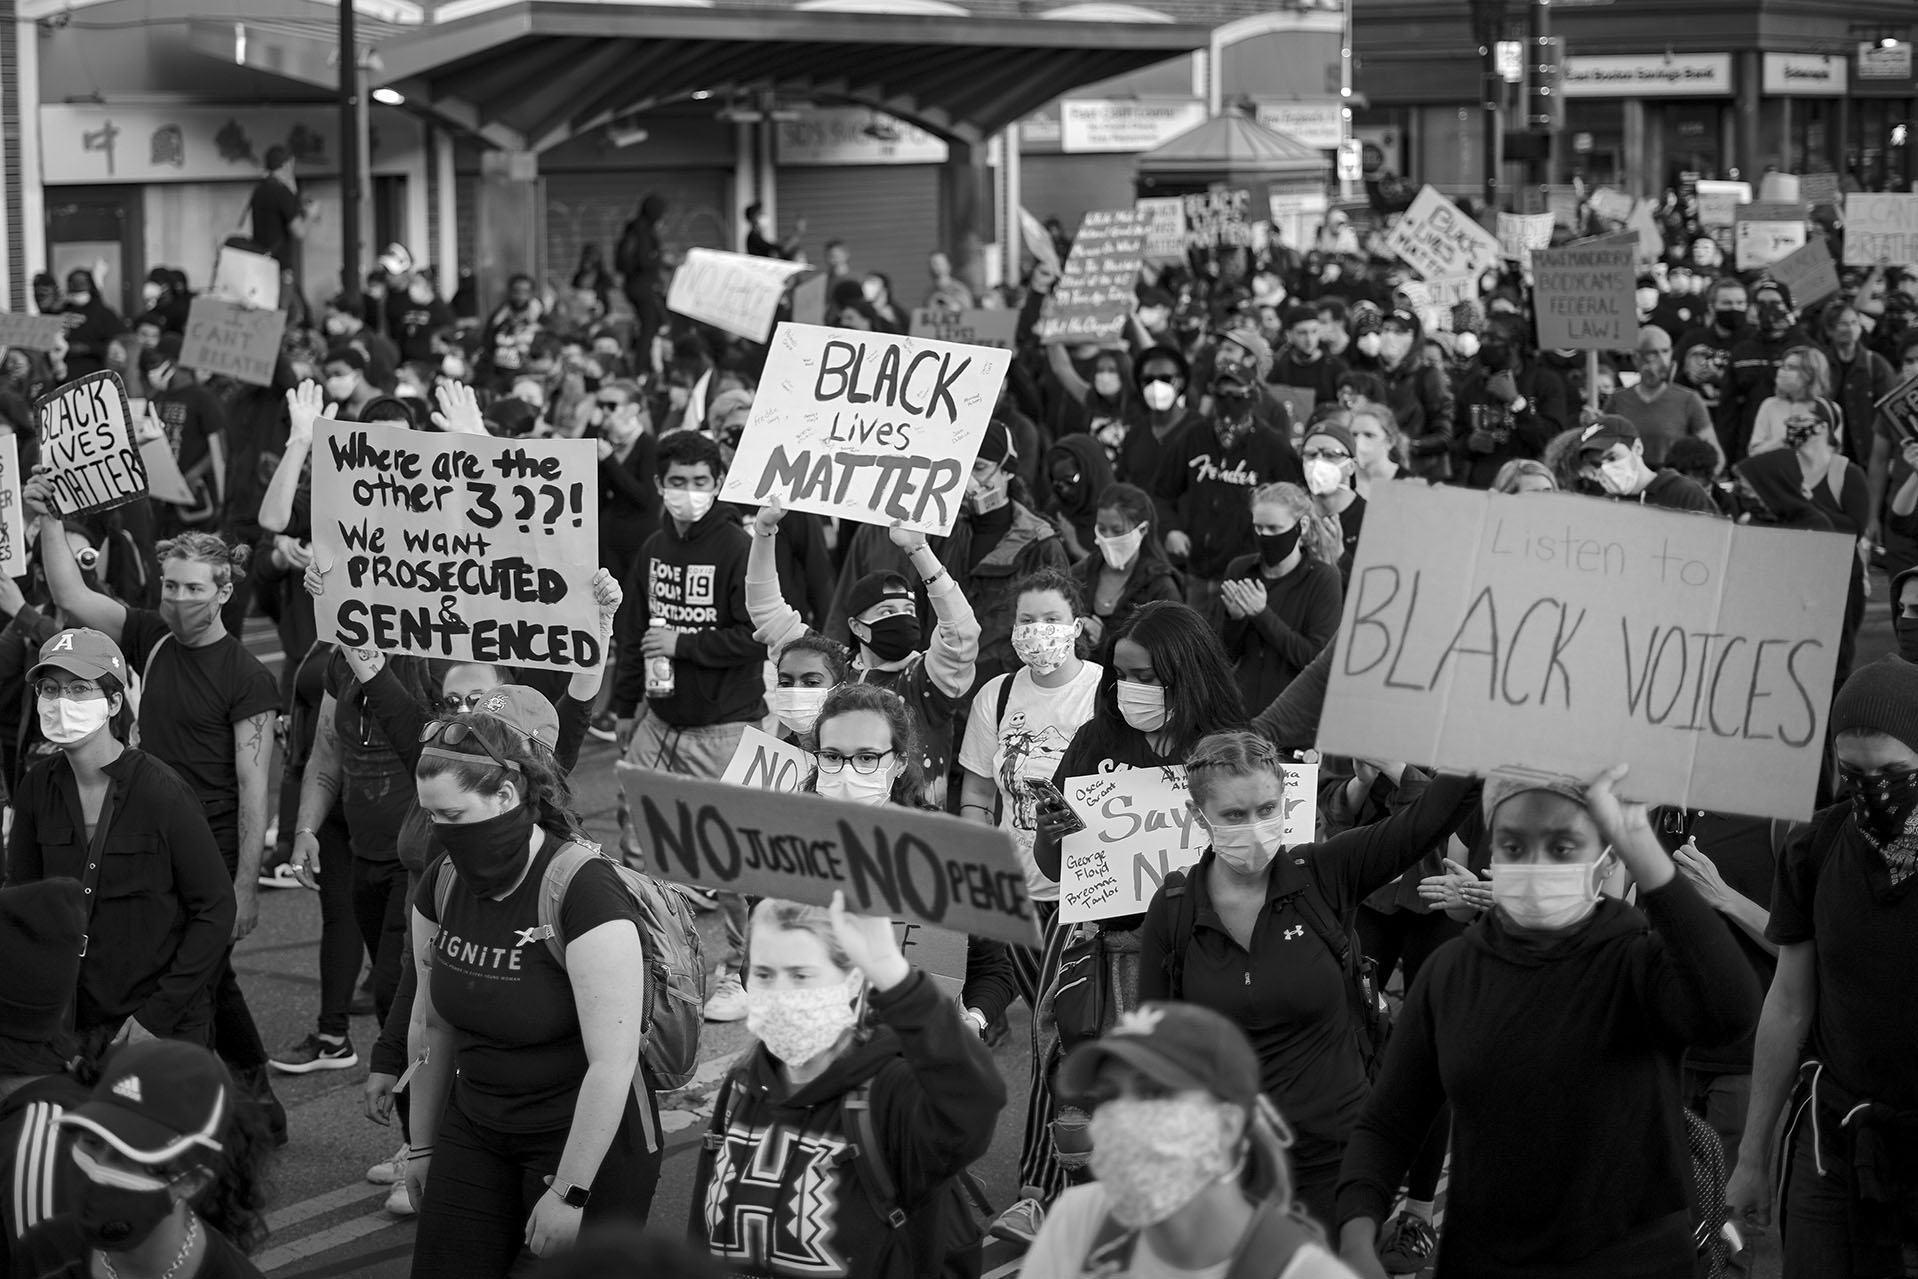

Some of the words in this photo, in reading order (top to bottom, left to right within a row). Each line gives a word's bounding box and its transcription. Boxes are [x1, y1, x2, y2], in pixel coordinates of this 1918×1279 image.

[1539, 271, 1625, 292] BODYCAMS
[1550, 295, 1619, 316] FEDERAL
[1568, 319, 1620, 340] LAW!
[815, 340, 972, 425] BLACK
[41, 378, 109, 445] BLACK
[830, 412, 911, 451] Lives
[328, 431, 422, 480] Where
[431, 450, 485, 482] are
[492, 448, 562, 481] the
[47, 448, 146, 510] MATTER
[353, 473, 454, 513] other
[754, 444, 962, 527] MATTER
[338, 518, 385, 553] We
[1491, 517, 1625, 577] Listen
[1650, 537, 1711, 586] to
[348, 556, 568, 605] PROSECUTED
[687, 575, 710, 597] 19
[51, 633, 74, 652] A
[336, 599, 601, 668] SENTENCED
[1344, 565, 1586, 709] BLACK
[1622, 616, 1824, 748] VOICES
[742, 744, 799, 793] NO
[1075, 779, 1104, 801] Oscar
[1098, 795, 1194, 849] Say
[640, 795, 742, 882] NO
[736, 826, 846, 882] JUSTICE
[838, 817, 948, 923] NO
[948, 859, 1033, 921] PEACE
[1066, 850, 1107, 870] George
[1075, 862, 1110, 881] Floyd
[1065, 875, 1118, 906] Breonna
[1081, 886, 1119, 910] Taylor
